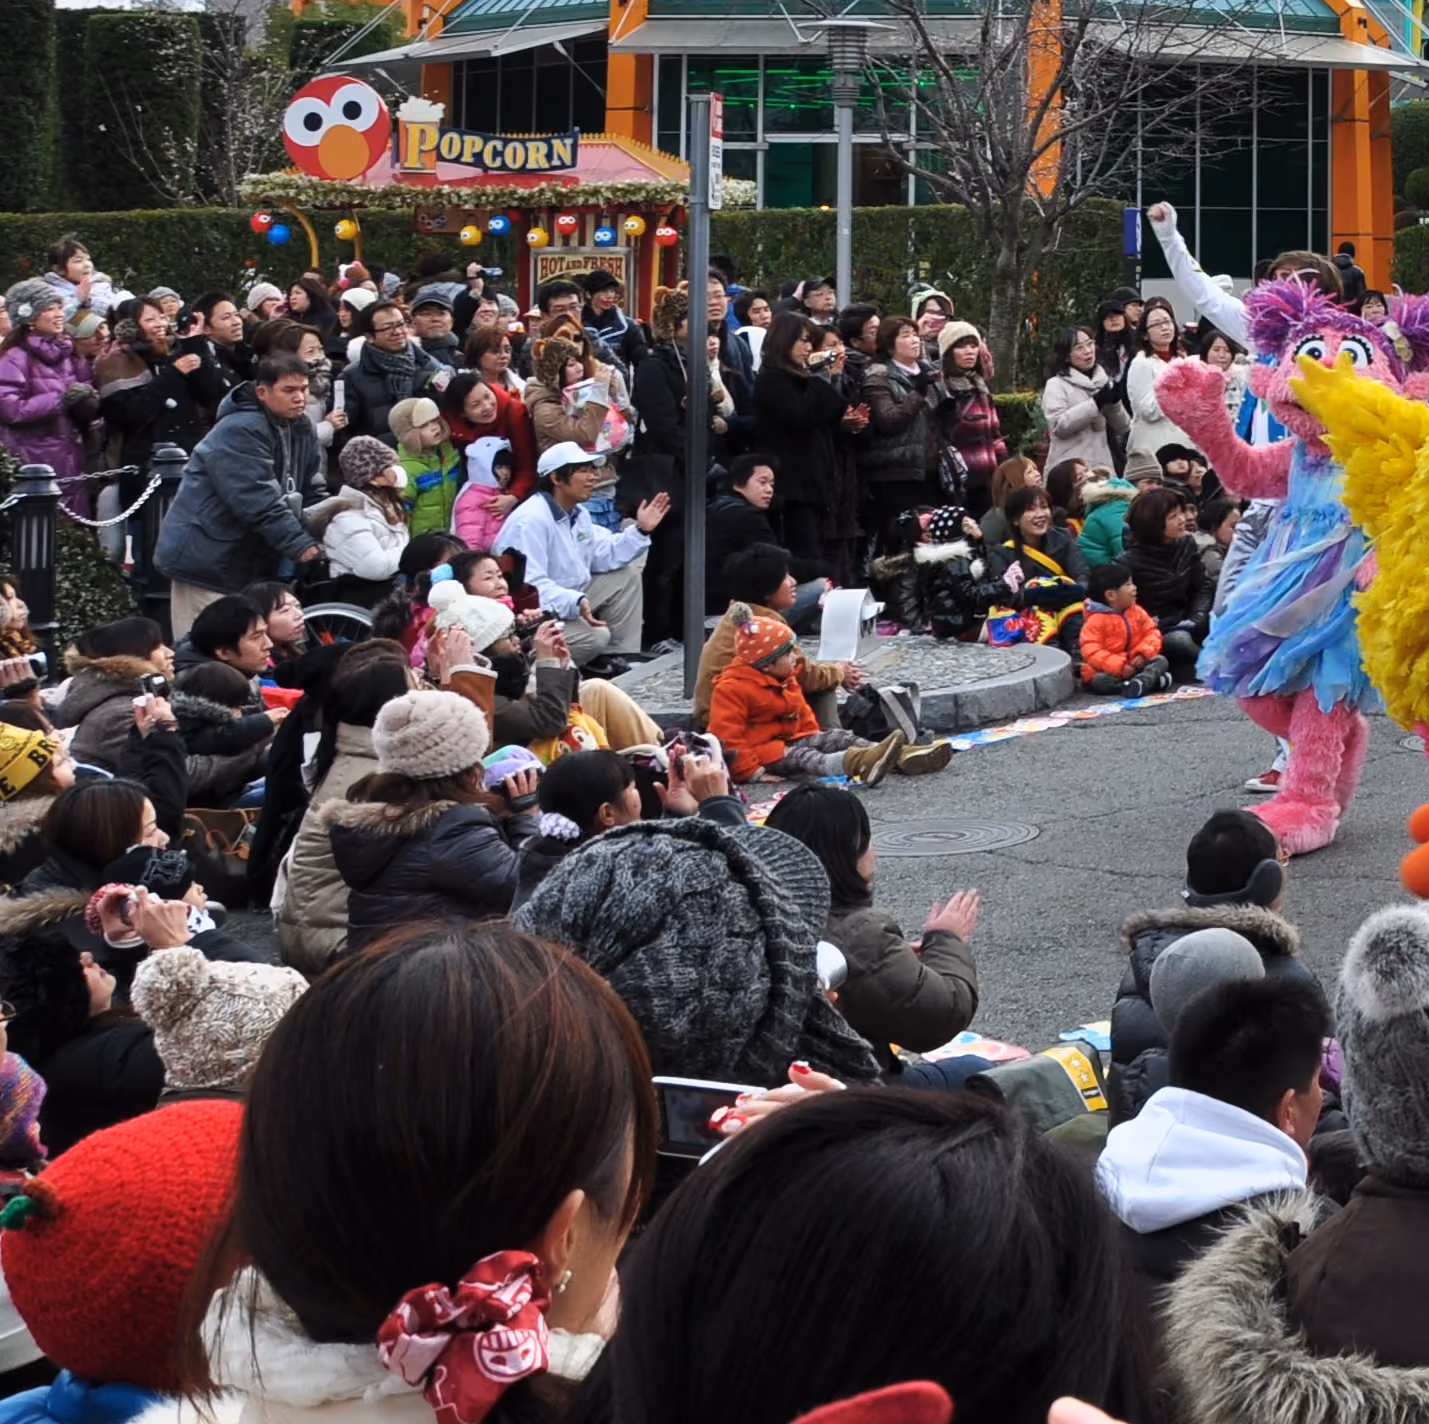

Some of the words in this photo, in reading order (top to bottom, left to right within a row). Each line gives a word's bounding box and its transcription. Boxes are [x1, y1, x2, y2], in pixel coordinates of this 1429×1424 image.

[404, 123, 576, 171] POPCORN
[541, 256, 566, 281] HOT
[566, 259, 583, 270] AND
[583, 256, 624, 281] FRESH
